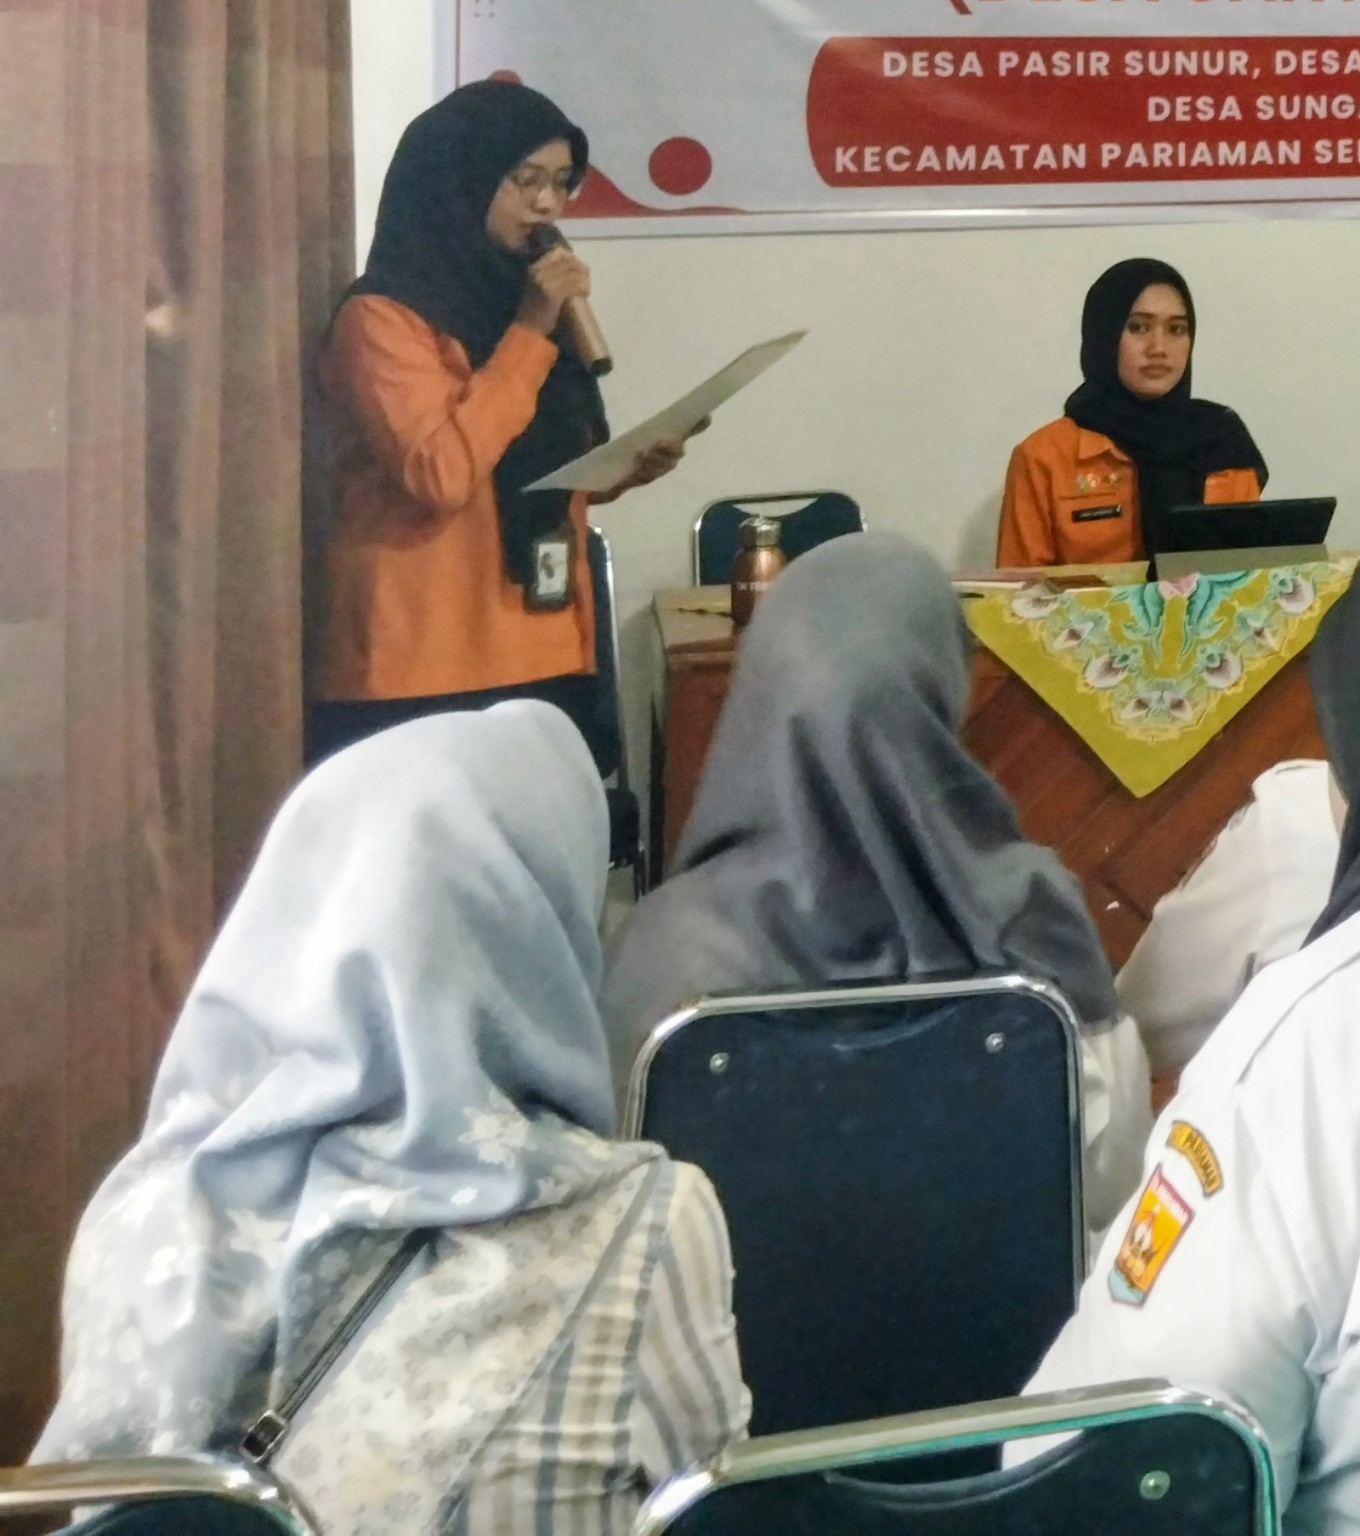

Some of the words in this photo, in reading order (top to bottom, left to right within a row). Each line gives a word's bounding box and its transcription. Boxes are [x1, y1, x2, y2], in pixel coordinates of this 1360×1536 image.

[882, 51, 984, 78] DESA
[999, 50, 1111, 77] PASIR
[1124, 50, 1262, 80] SUNUR,
[1147, 96, 1243, 122] DESA
[835, 143, 1087, 173] KECAMATAN
[1101, 140, 1302, 168] PARIAMAN
